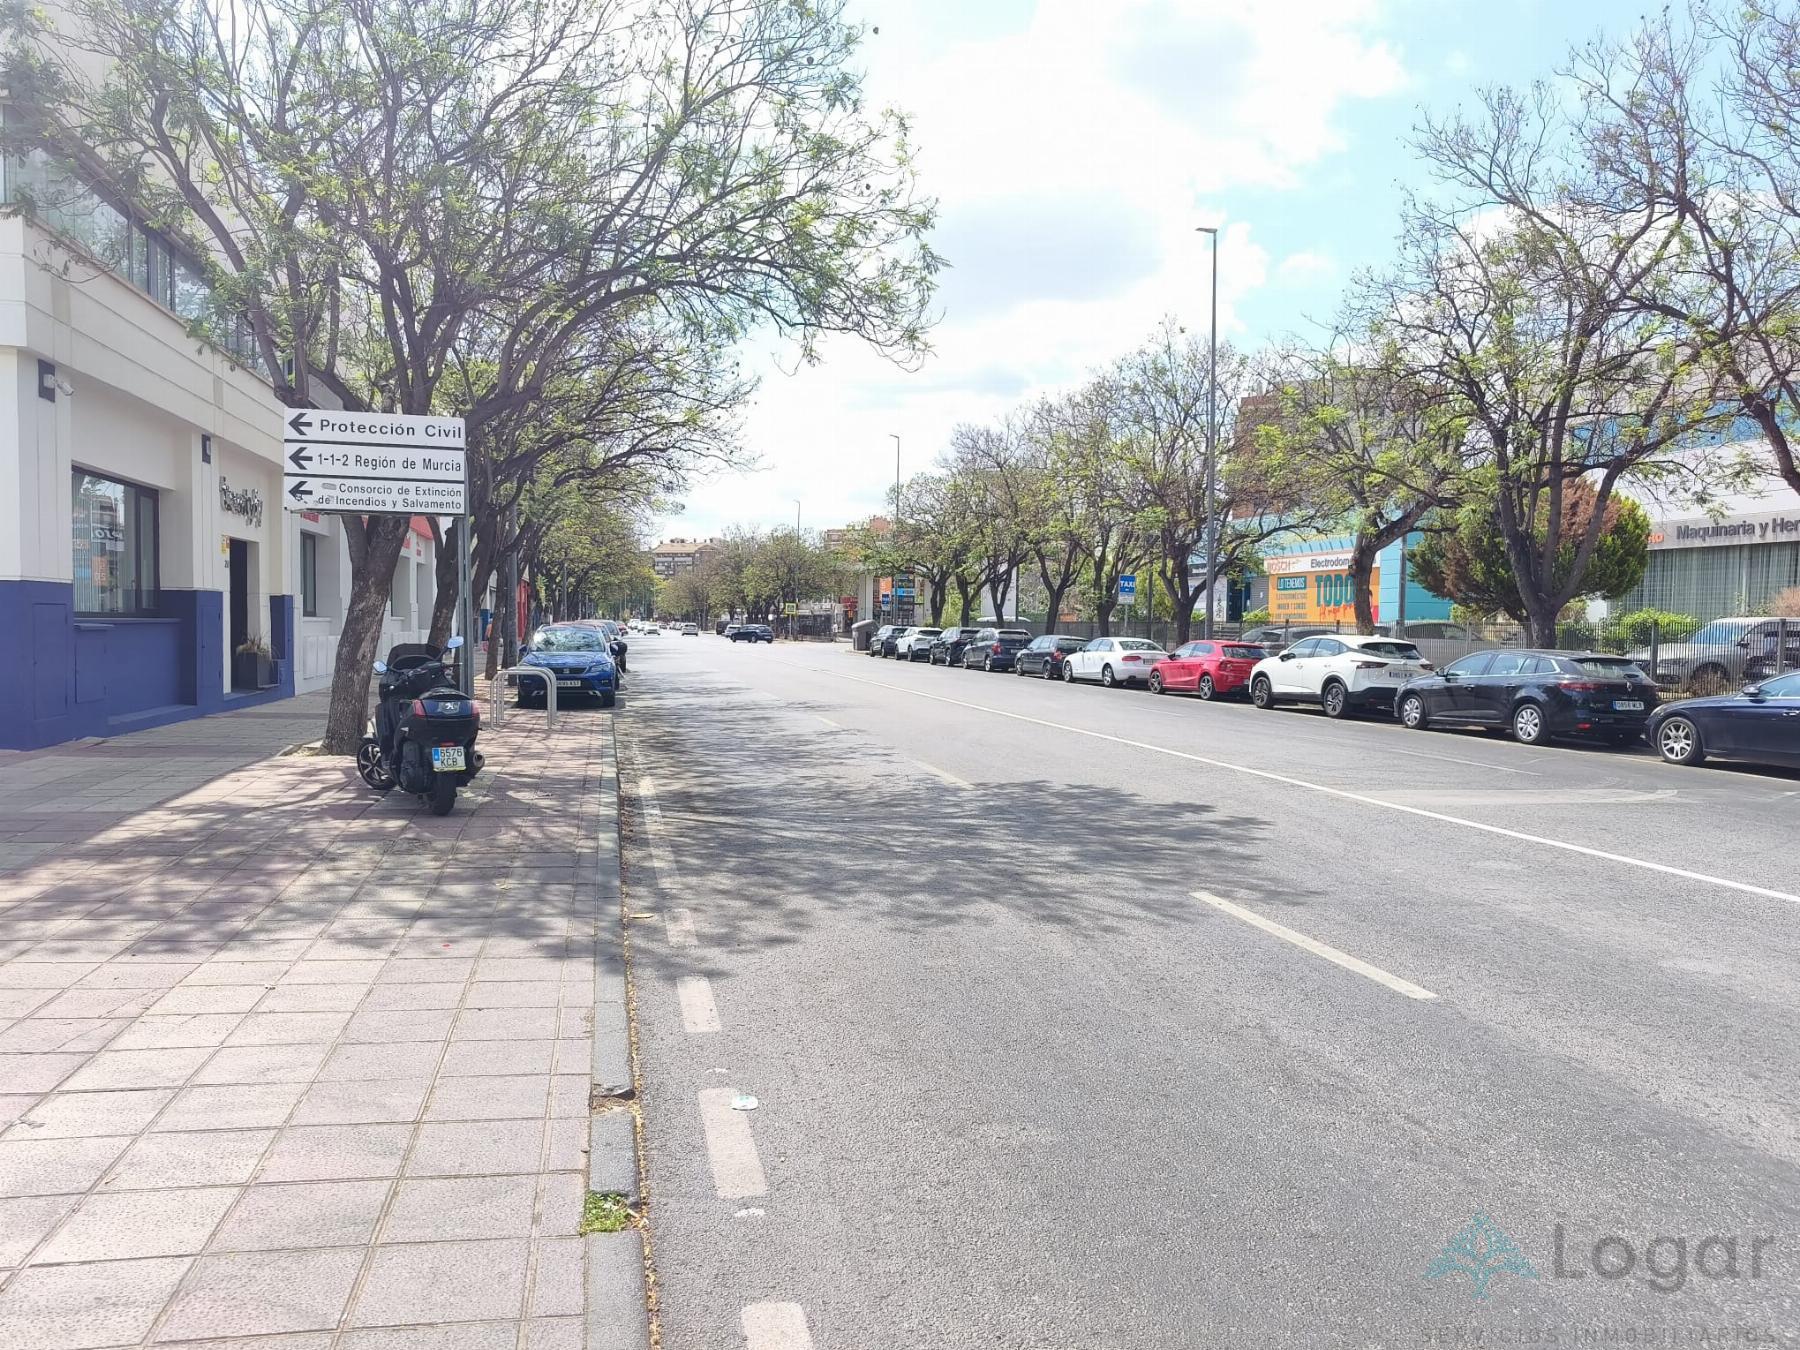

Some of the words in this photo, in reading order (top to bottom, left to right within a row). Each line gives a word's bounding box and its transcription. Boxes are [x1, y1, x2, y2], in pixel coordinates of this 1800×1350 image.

[320, 419, 416, 436] Protección
[424, 424, 462, 439] Civil
[317, 453, 349, 467] 1-1-2
[355, 455, 396, 471] Región
[402, 457, 417, 469] de
[422, 458, 462, 472] Murcia
[339, 483, 393, 495] Consorcio
[397, 484, 411, 496] de
[415, 485, 462, 497] Extinción
[317, 495, 331, 505] de
[335, 495, 387, 507] Incendios
[391, 500, 398, 509] y
[402, 498, 462, 510] Salvamento
[1676, 520, 1756, 542] Maquinaria
[1758, 521, 1770, 538] y
[1310, 558, 1351, 569] Electrodom
[1315, 573, 1356, 608] TODO
[440, 748, 463, 758] 6576
[440, 757, 458, 767] KCB
